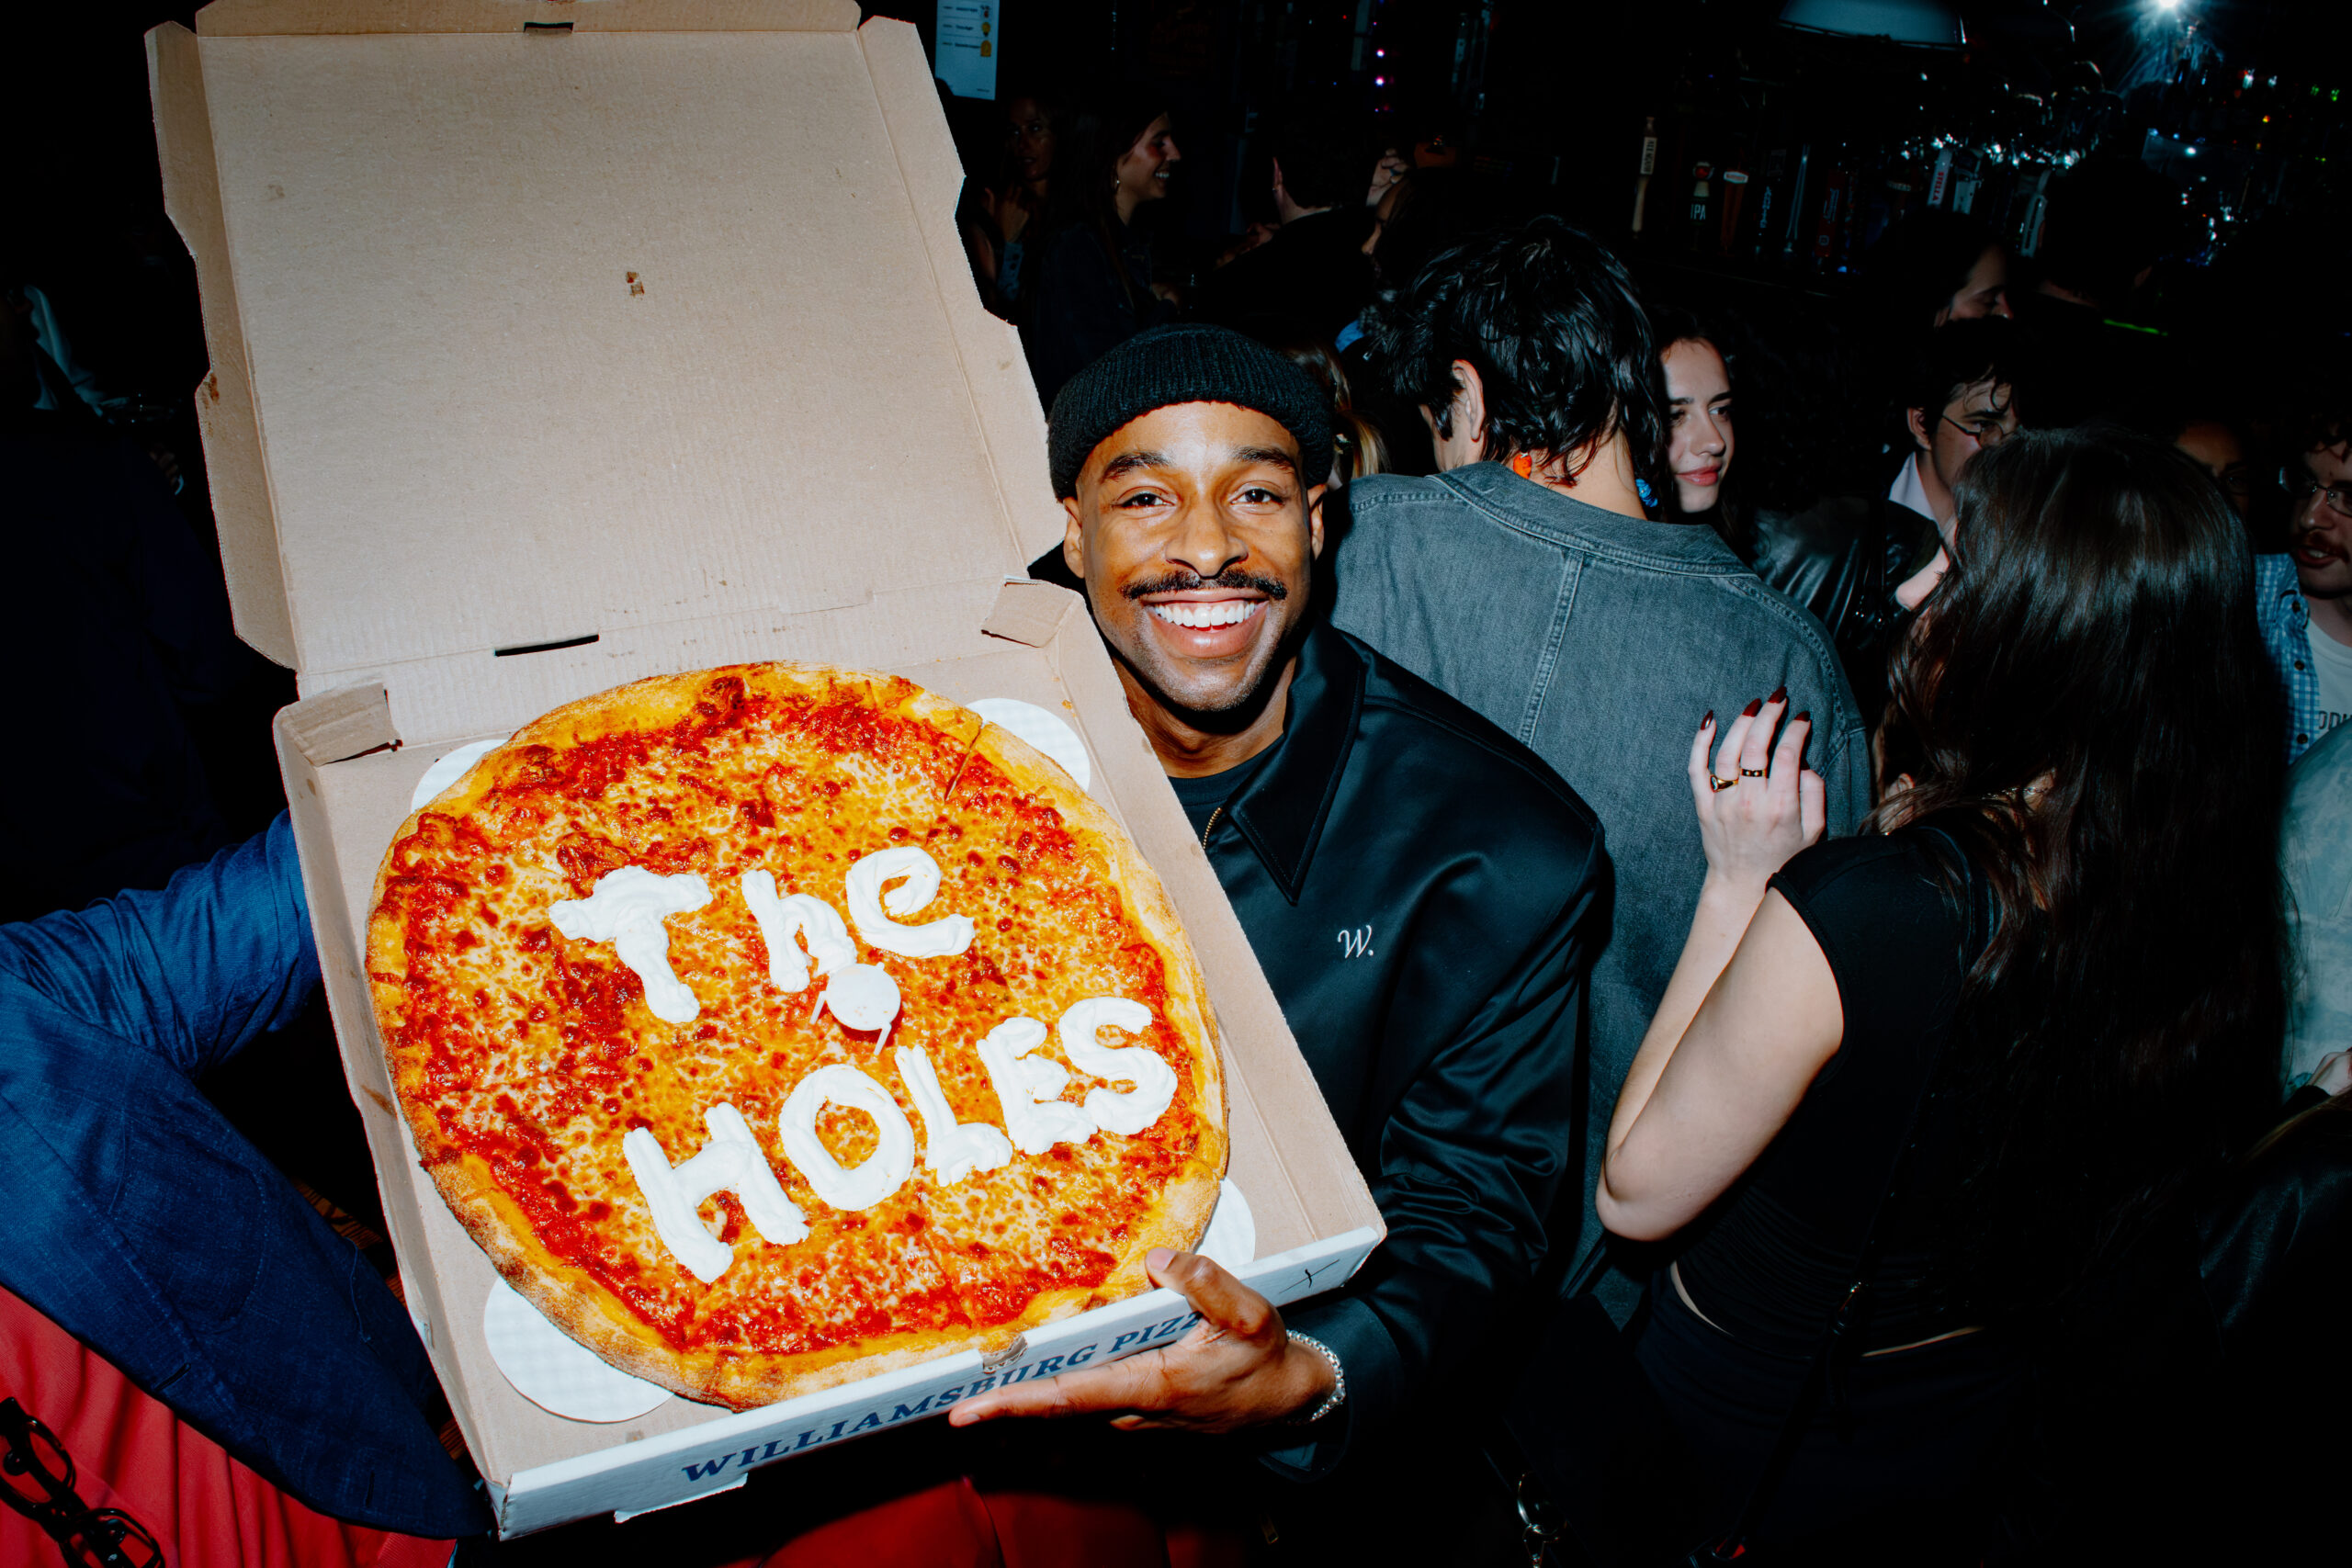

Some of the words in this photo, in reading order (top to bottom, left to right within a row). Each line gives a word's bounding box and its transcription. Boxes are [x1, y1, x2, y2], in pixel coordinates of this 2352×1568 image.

[1690, 203, 1706, 221] IPA
[1932, 172, 1945, 201] STELLA
[551, 846, 975, 1023] The
[1337, 924, 1374, 959] W.
[623, 997, 1178, 1283] HOLES
[681, 1343, 1098, 1482] WILLIAMSBURG
[1108, 1311, 1204, 1354] PIZZ
